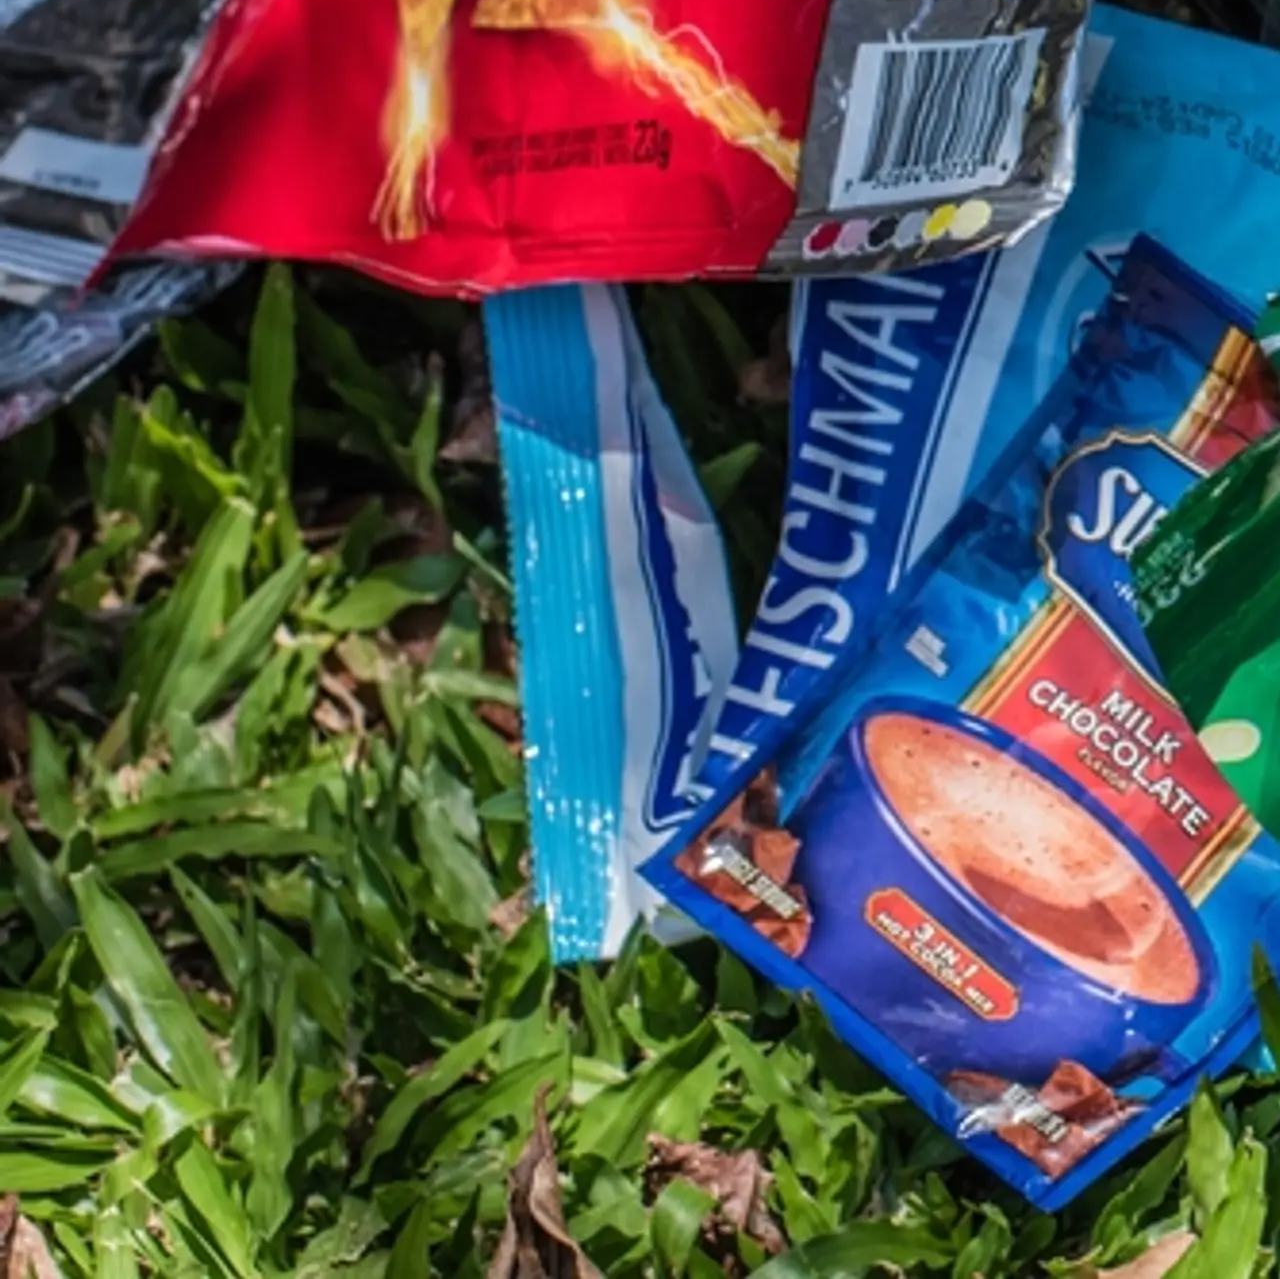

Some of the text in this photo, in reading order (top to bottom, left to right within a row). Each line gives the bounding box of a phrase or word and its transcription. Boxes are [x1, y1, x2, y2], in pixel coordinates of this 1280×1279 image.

[1028, 678, 1211, 837] CHOCOLATE
[1101, 689, 1182, 764] MILK
[913, 922, 936, 941] 3
